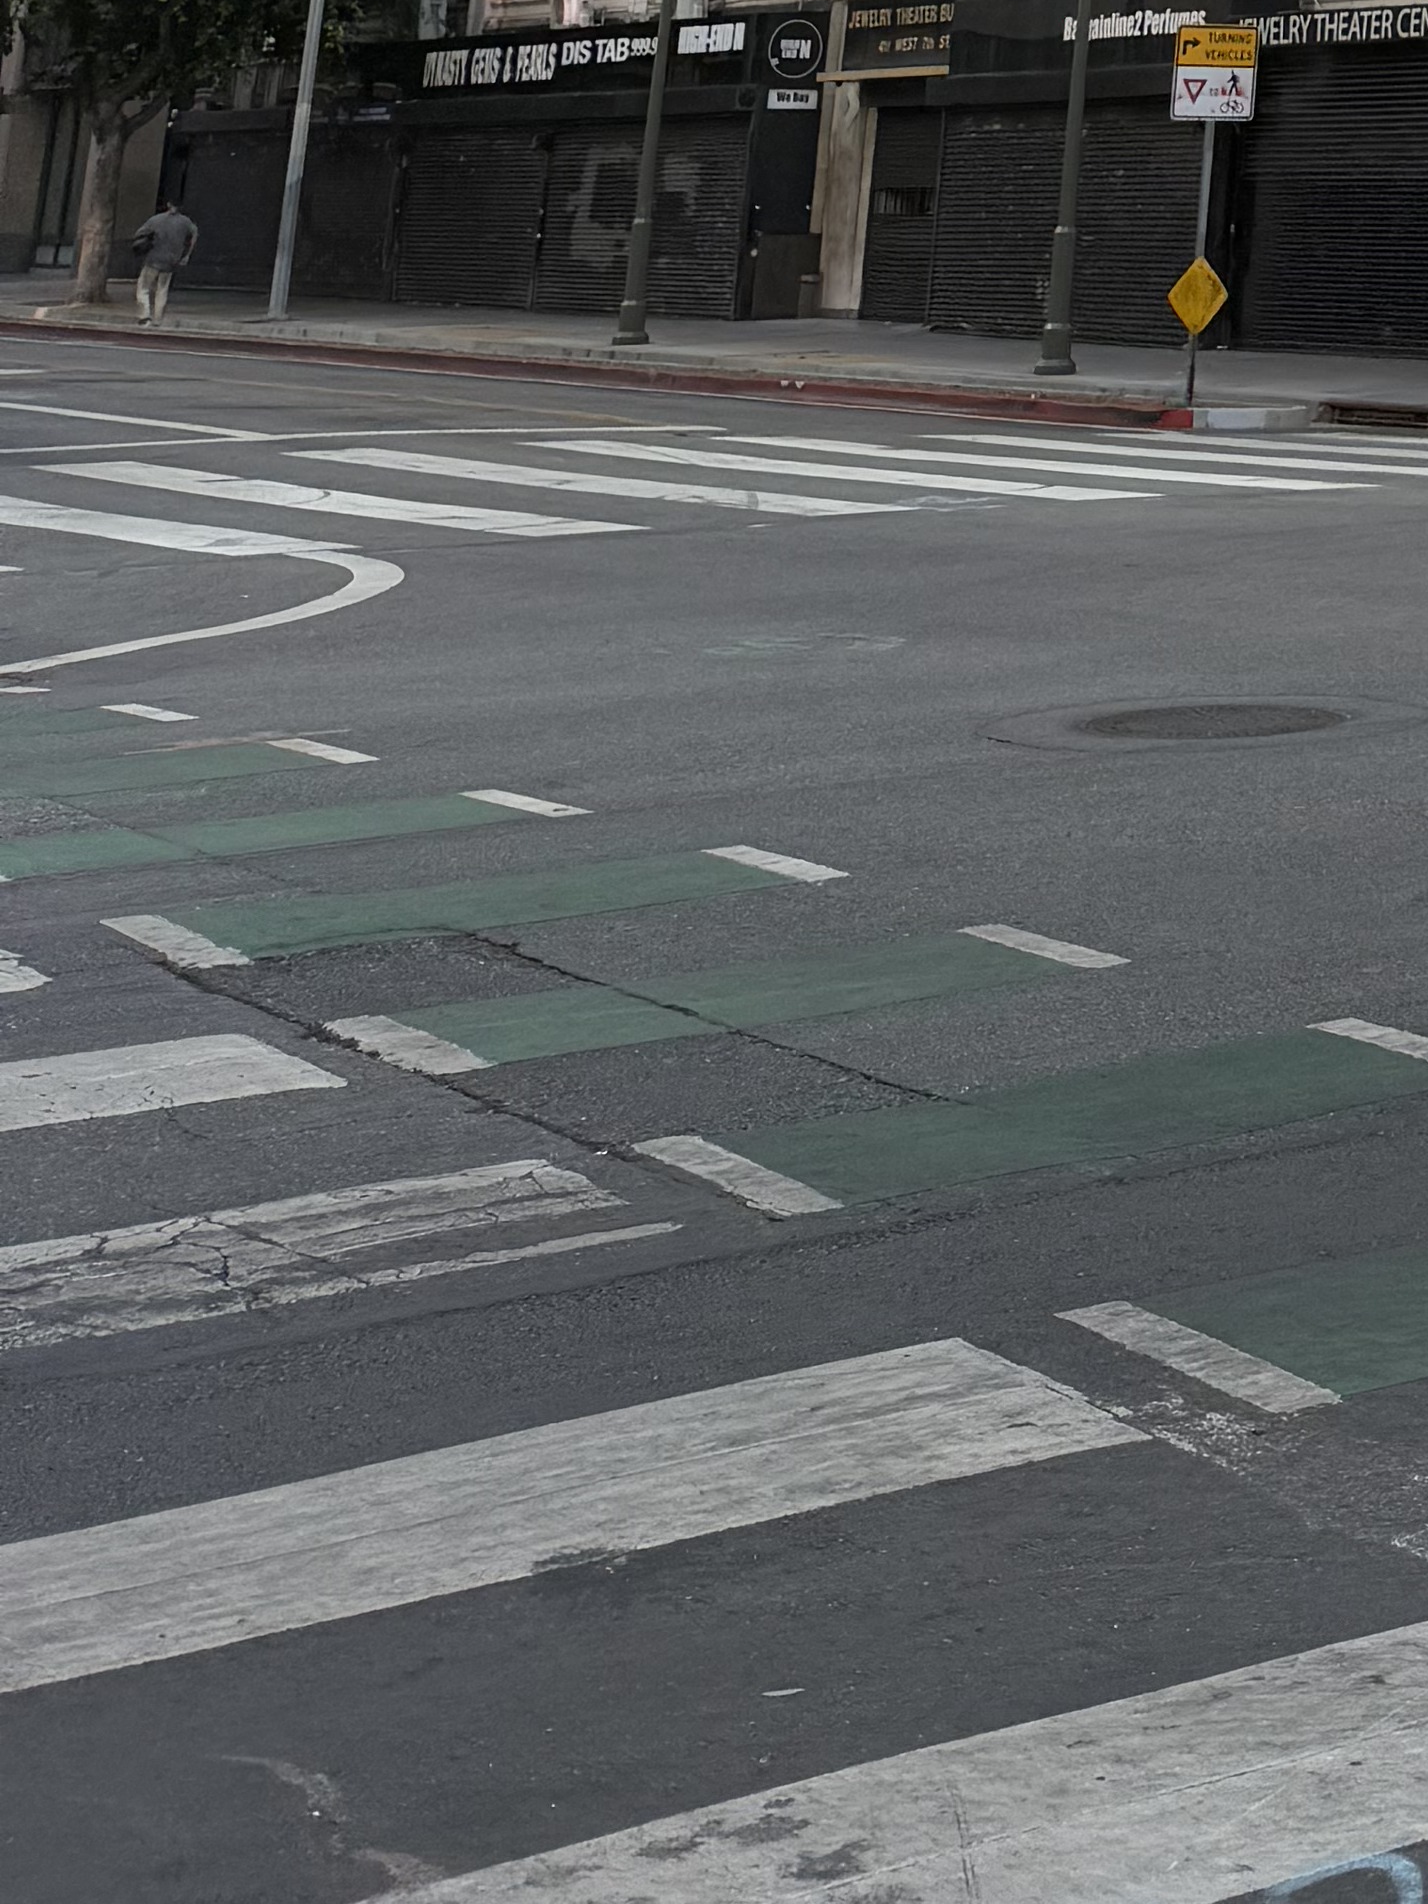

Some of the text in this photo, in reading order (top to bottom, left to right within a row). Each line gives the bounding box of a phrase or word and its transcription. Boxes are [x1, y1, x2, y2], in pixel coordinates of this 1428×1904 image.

[896, 4, 938, 25] THEATER
[1315, 10, 1393, 42] THEATER
[470, 47, 503, 86] GEMS
[515, 42, 558, 83] PEARLS
[561, 38, 630, 66] DIS TAB
